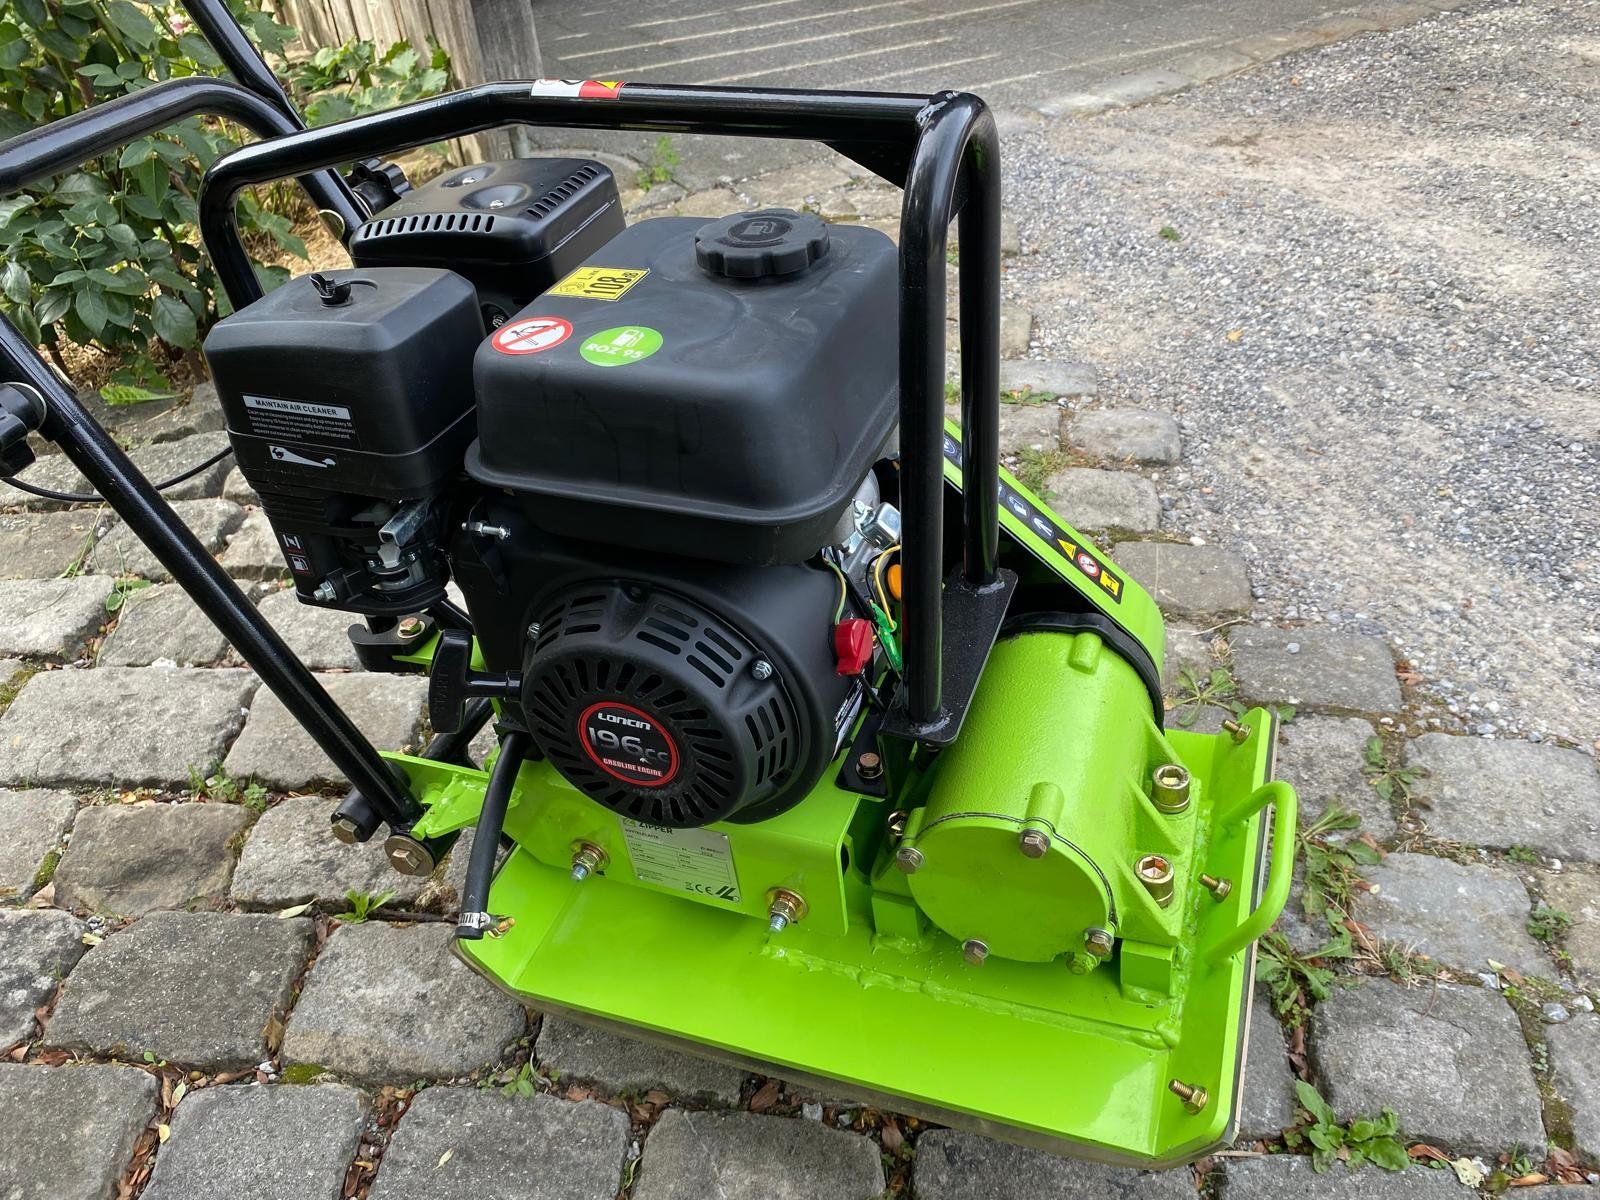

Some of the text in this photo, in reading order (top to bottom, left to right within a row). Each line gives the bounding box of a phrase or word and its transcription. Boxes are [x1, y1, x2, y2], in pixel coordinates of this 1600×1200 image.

[583, 276, 632, 295] 108
[585, 343, 644, 358] ROZ 95
[255, 400, 337, 415] MAINTAIN AIR CLEANER
[603, 758, 663, 777] GASOLINE ENGINE
